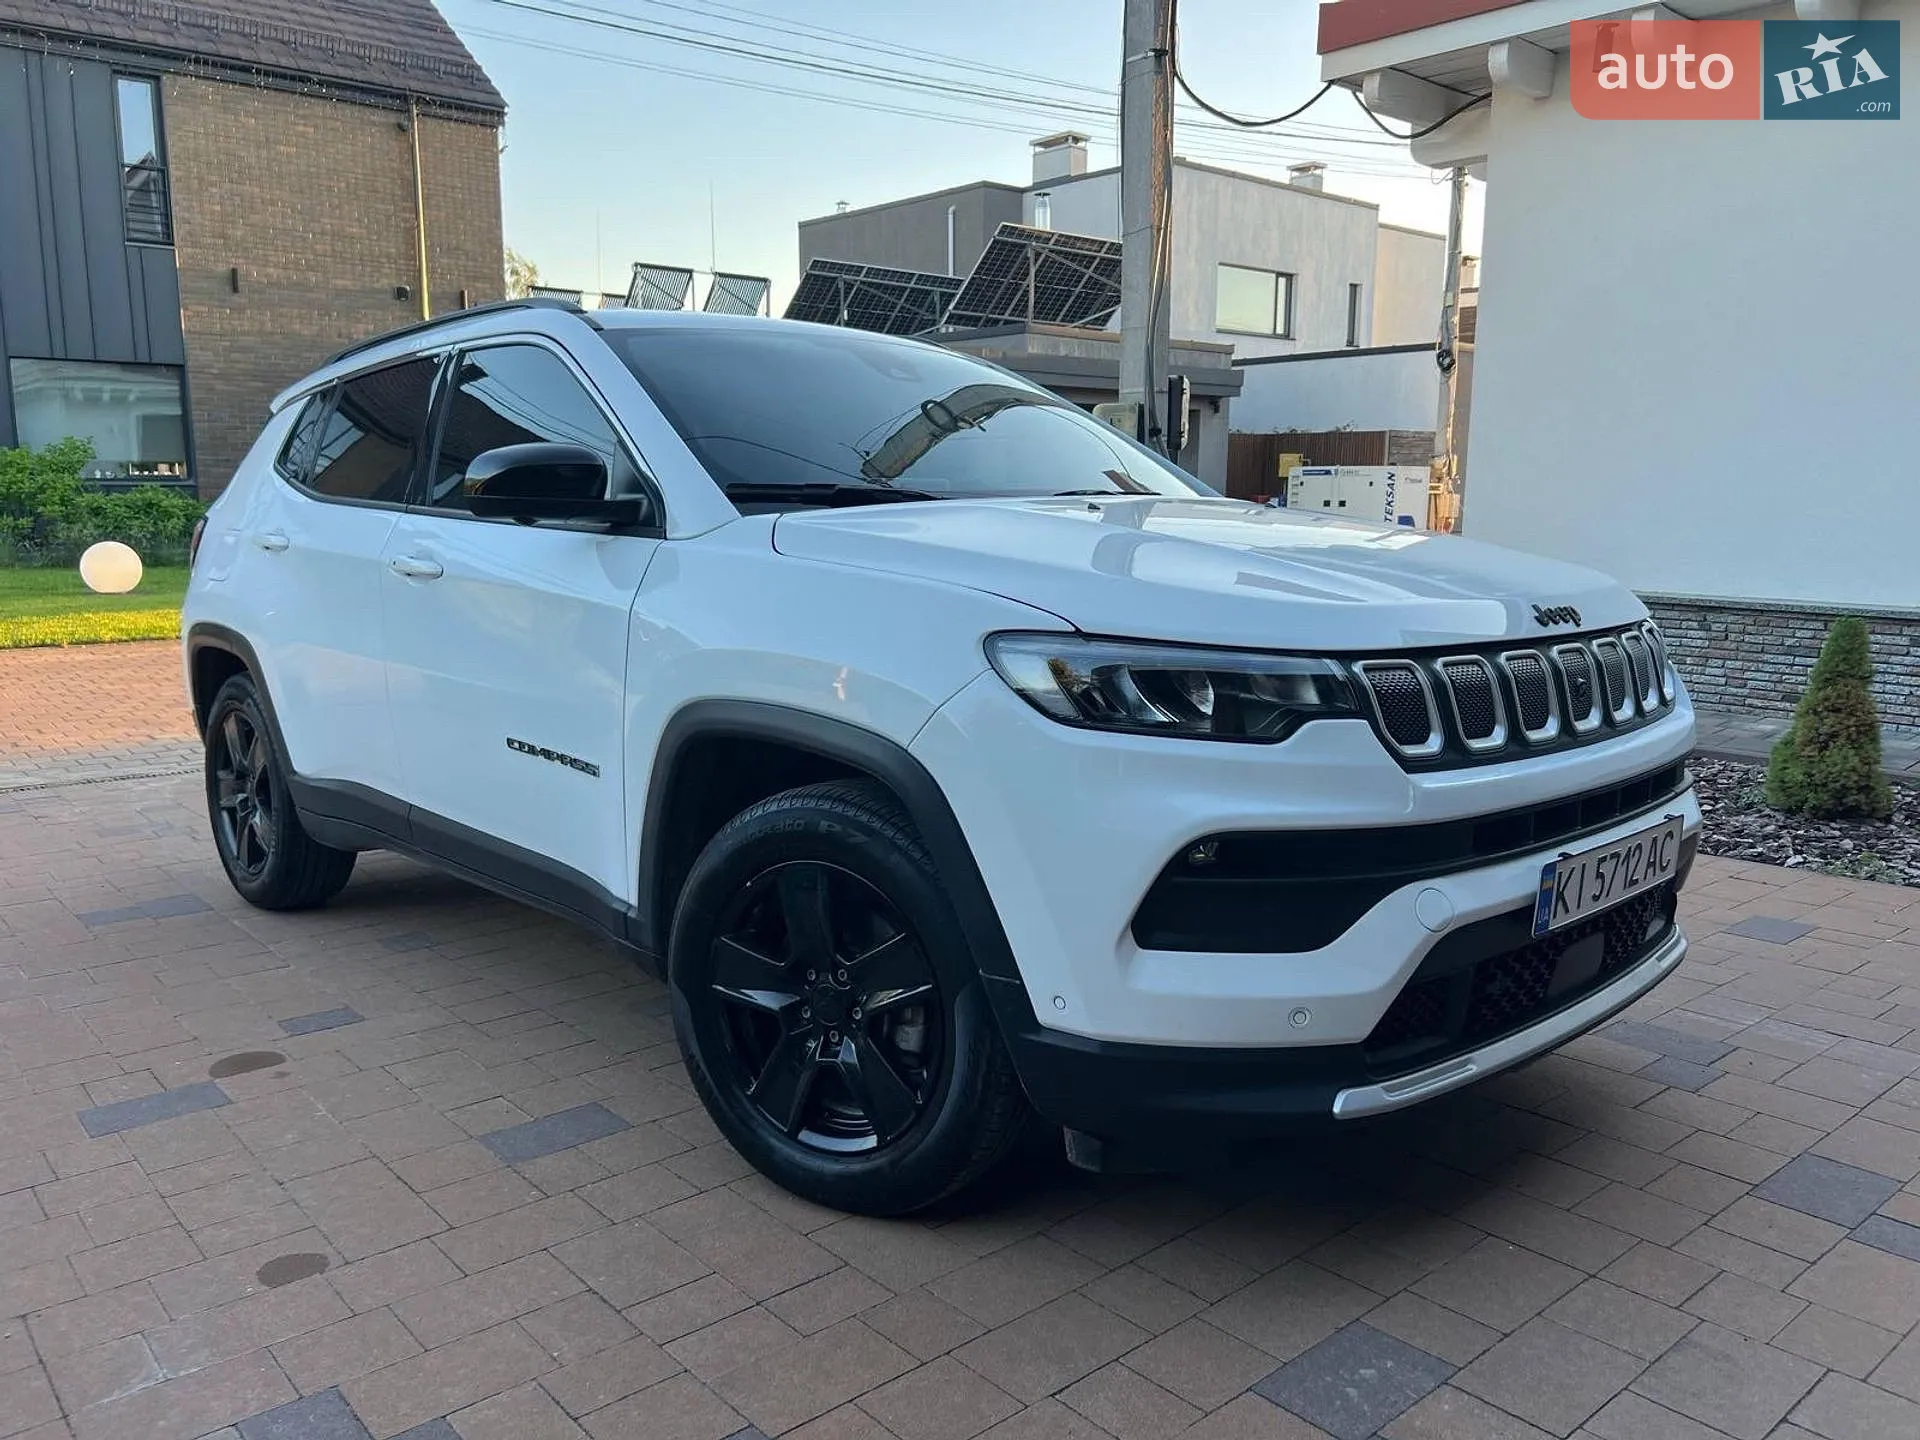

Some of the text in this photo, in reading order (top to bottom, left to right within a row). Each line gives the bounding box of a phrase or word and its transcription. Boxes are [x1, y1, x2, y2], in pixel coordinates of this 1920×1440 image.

[1384, 471, 1396, 522] TEKSAN
[1531, 604, 1581, 628] Jeep
[506, 736, 600, 778] COMPASS
[1553, 830, 1674, 919] KI 5712 AC
